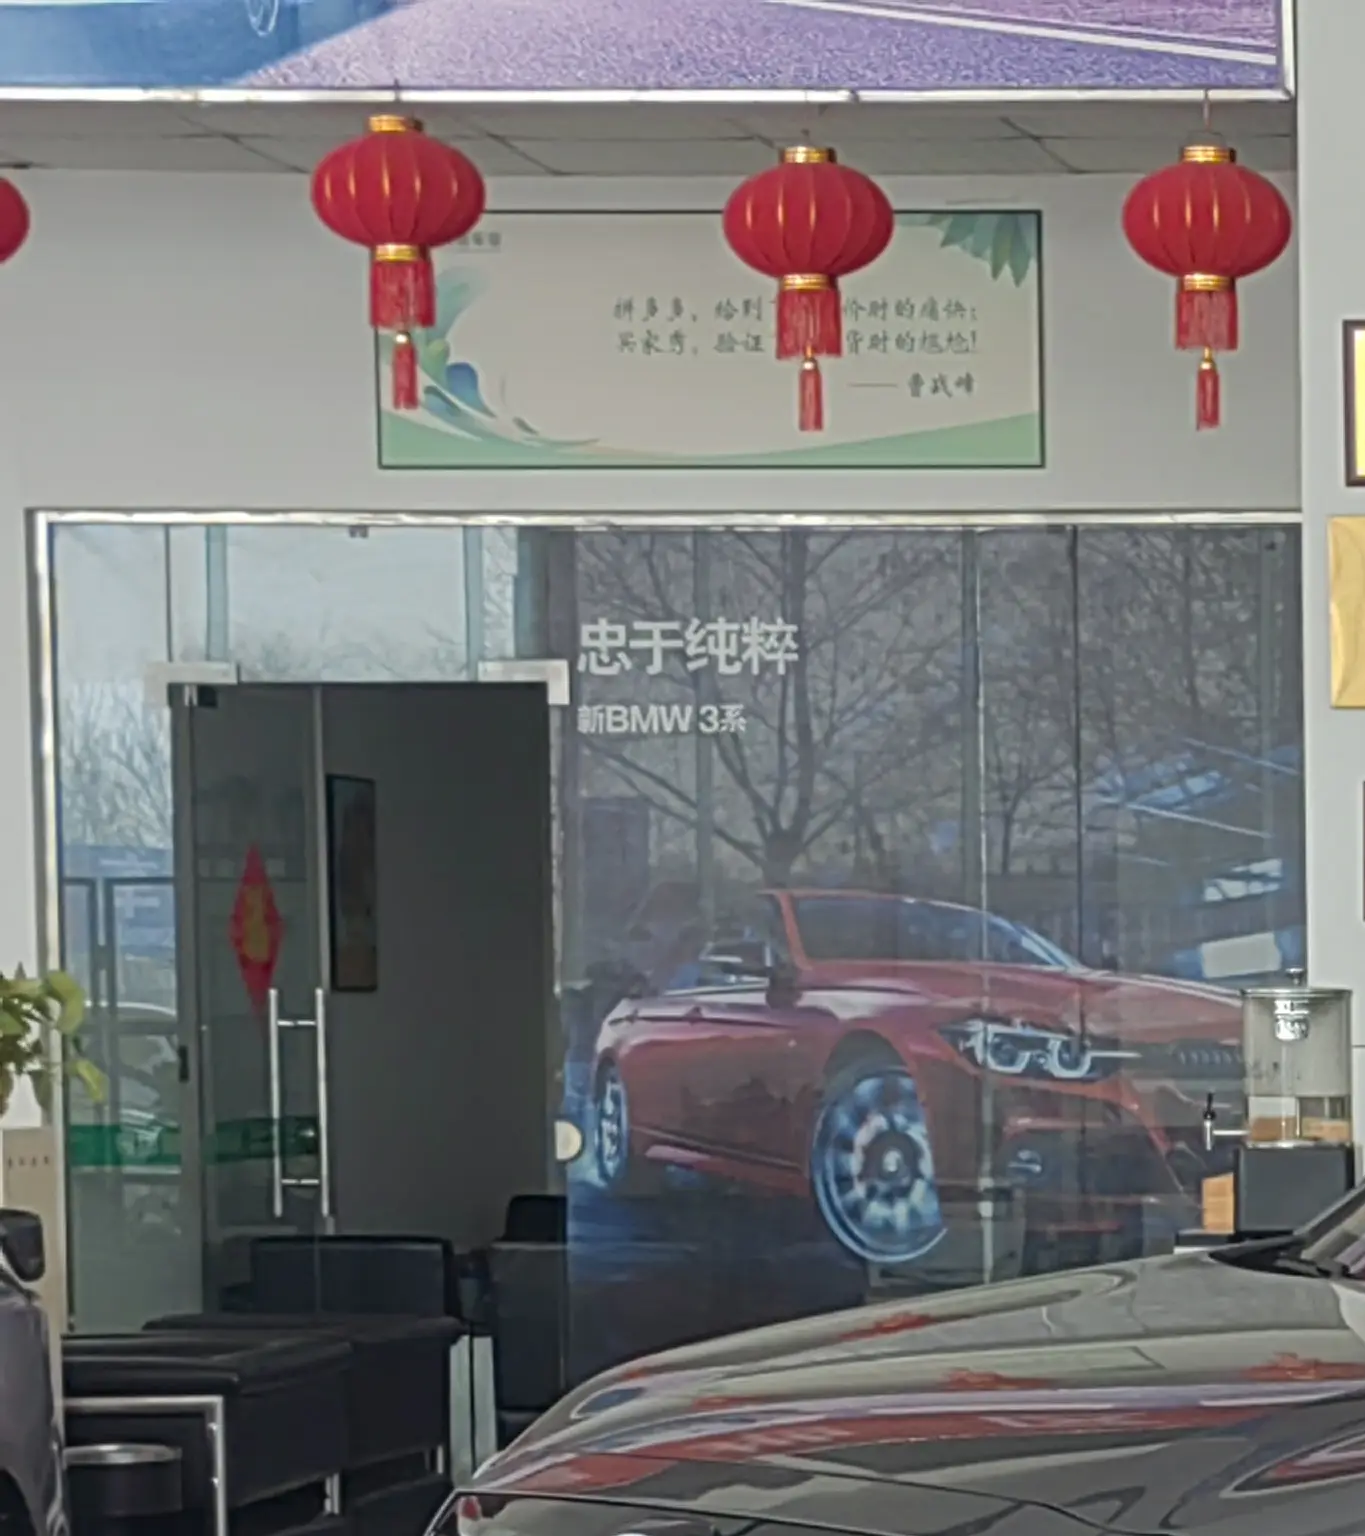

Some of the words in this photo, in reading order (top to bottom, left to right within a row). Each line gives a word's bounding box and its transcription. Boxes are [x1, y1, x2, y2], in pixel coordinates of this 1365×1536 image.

[577, 616, 799, 675] 忠于纯粹
[577, 703, 693, 734] 新BMW
[699, 703, 748, 734] 3系
